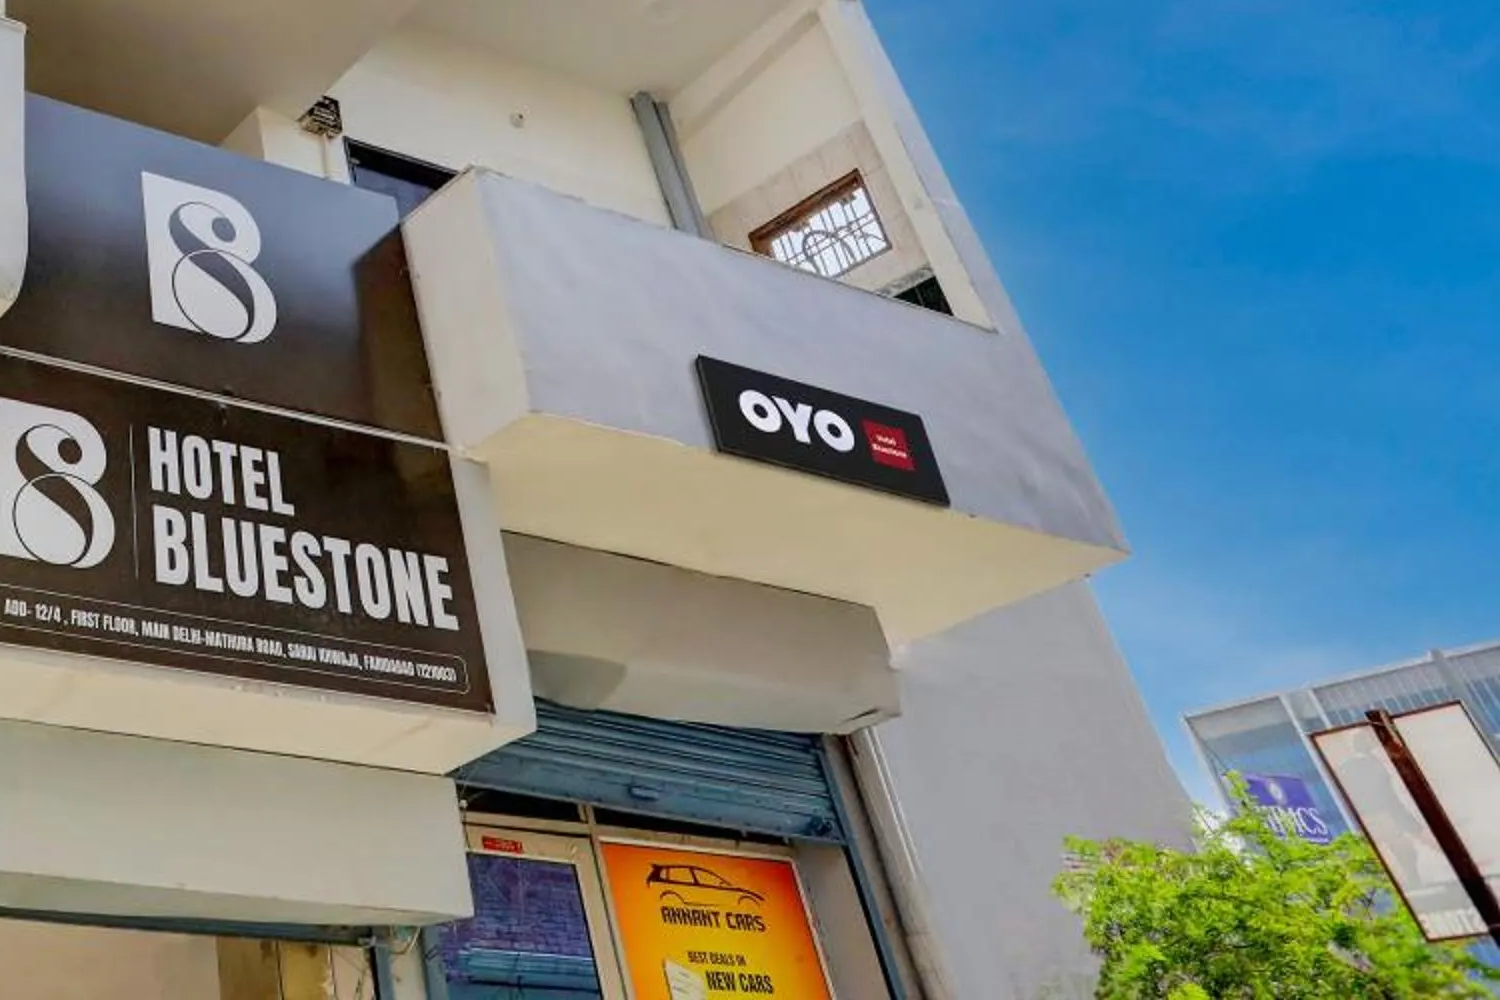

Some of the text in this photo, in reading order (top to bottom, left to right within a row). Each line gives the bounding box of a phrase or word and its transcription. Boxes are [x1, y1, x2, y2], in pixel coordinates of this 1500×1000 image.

[739, 389, 855, 451] OYO
[148, 426, 295, 516] HOTEL
[153, 504, 460, 631] BLUESTONE
[71, 609, 101, 629] FIRST
[103, 614, 139, 636] FLOOR,
[141, 620, 170, 639] MAIN
[725, 912, 766, 932] CARS
[687, 951, 706, 965] BEST
[710, 952, 734, 965] DEALS
[706, 970, 736, 991] NEW
[739, 973, 774, 994] CARS
